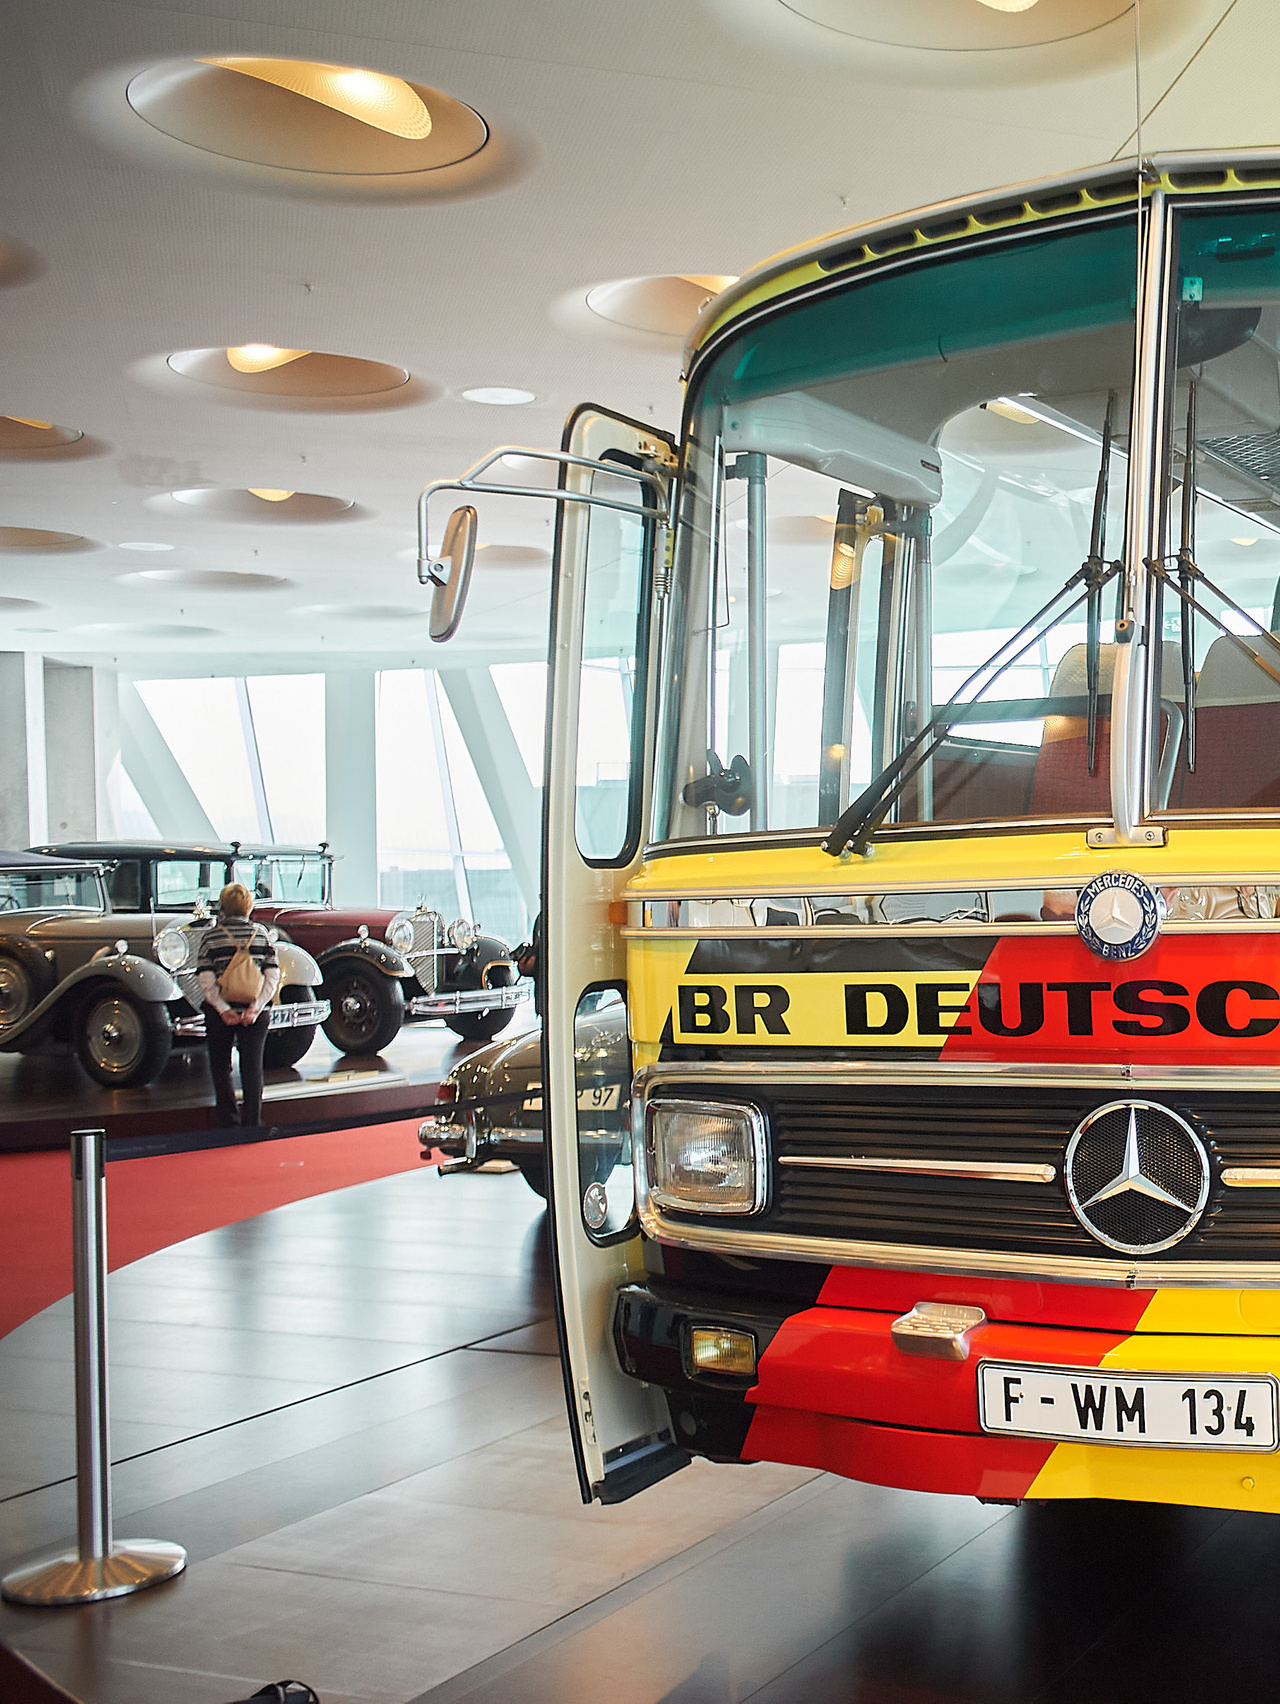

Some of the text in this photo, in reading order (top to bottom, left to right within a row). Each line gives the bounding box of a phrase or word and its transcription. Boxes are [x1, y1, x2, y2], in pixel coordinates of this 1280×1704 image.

[1086, 873, 1148, 899] MERCEDES
[1102, 943, 1136, 959] BENZ
[678, 984, 791, 1035] BR
[592, 1087, 614, 1107] 97
[1071, 1383, 1146, 1434] WM
[1181, 1388, 1256, 1437] 134
